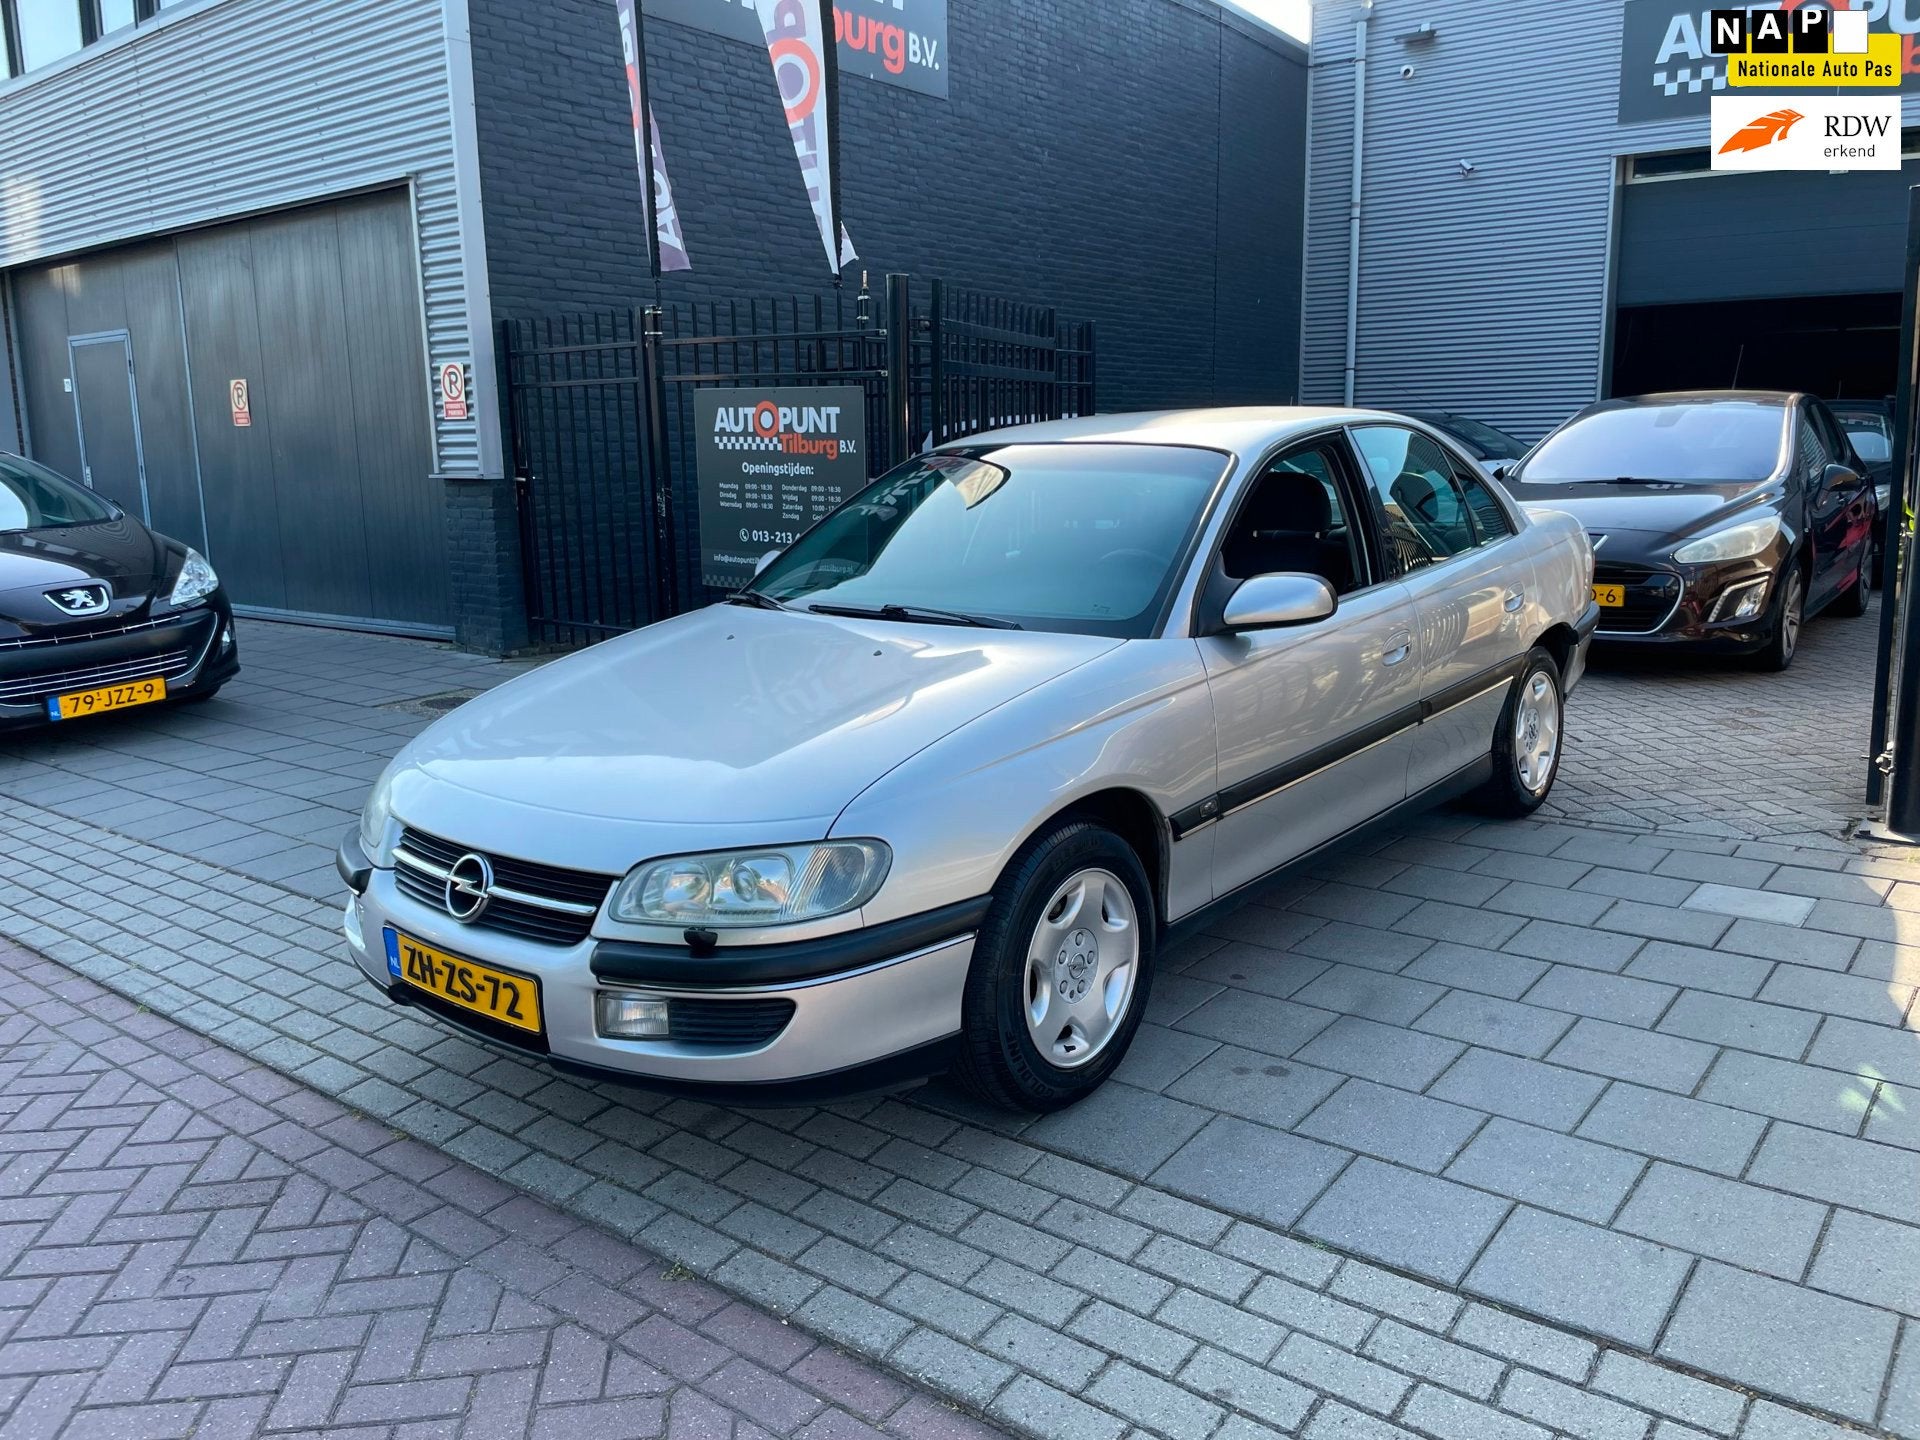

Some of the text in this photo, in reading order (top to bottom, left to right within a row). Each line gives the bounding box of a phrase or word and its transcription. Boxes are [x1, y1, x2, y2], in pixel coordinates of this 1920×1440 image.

[909, 31, 939, 70] B.V.
[714, 400, 840, 438] AUTOPUNT
[780, 433, 857, 460] Tilburg B.V.
[742, 461, 814, 477] Openingstijden:
[69, 683, 155, 713] 79-JZZ-9
[390, 955, 400, 969] NL
[403, 944, 524, 1020] ZH-ZS-72
